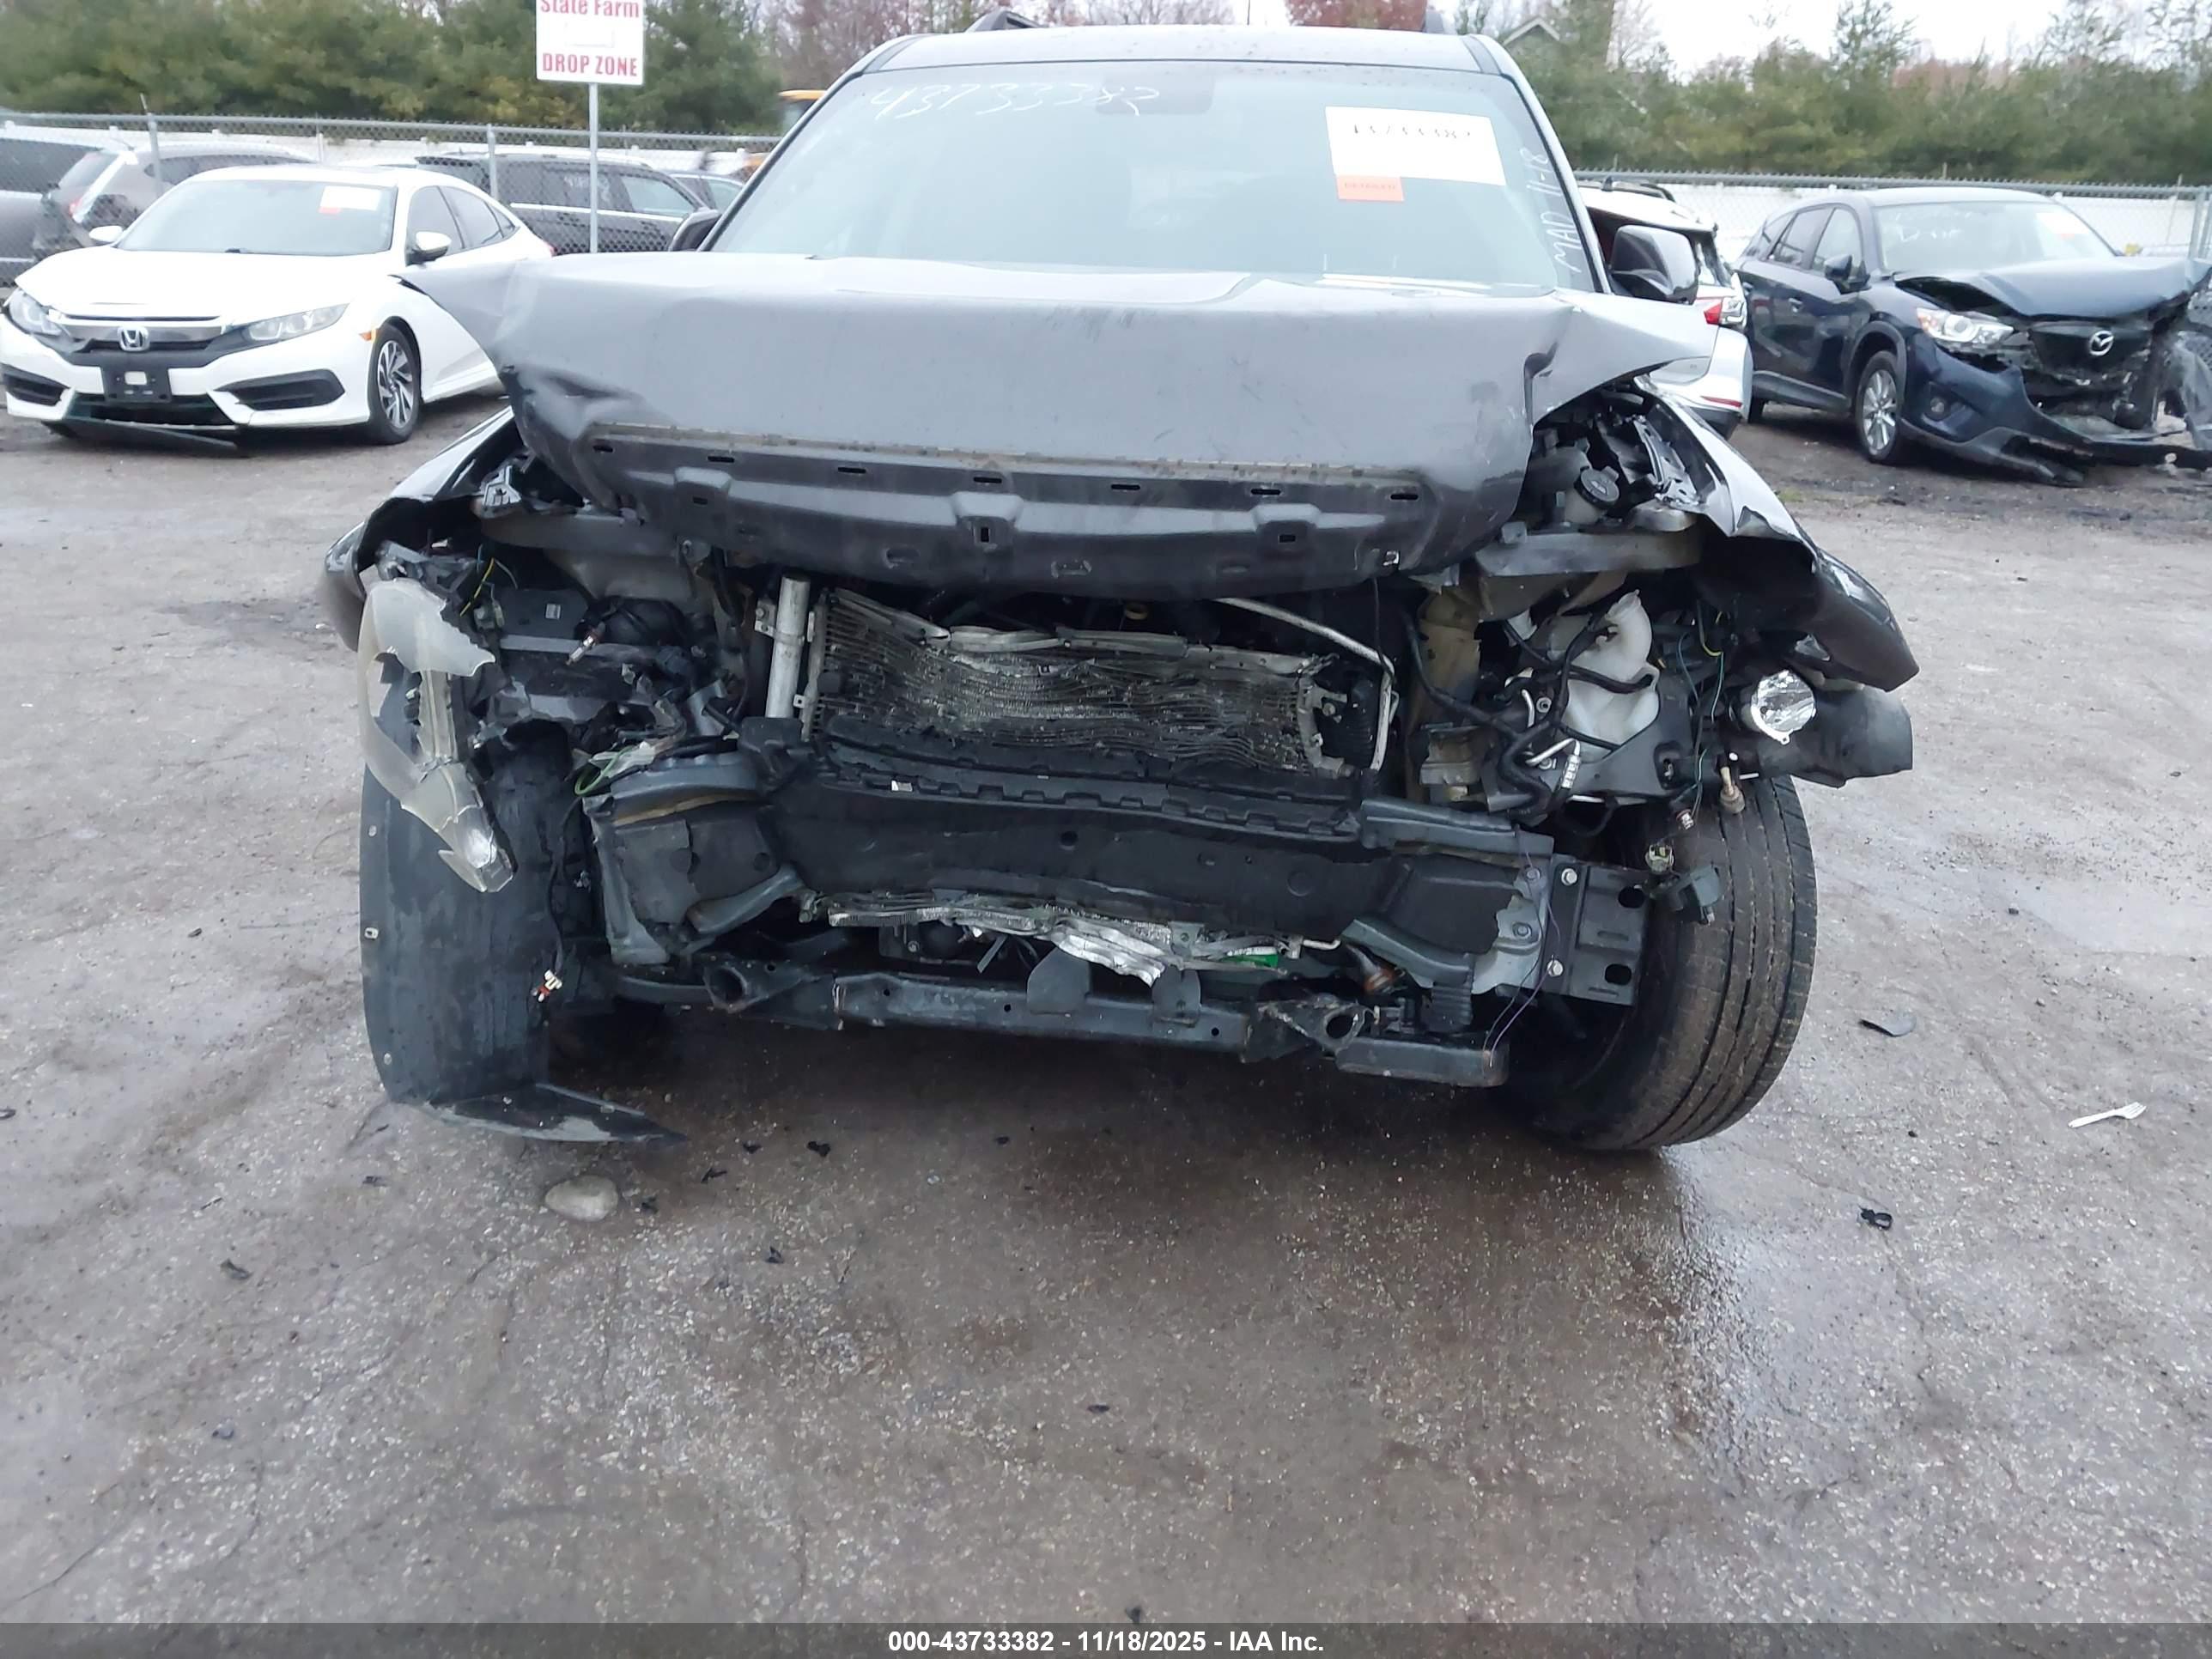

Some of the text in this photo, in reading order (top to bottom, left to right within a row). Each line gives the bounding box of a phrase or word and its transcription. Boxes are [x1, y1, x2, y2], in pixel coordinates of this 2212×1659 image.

[540, 0, 640, 18] State Farm
[542, 52, 637, 76] DROP ZONE
